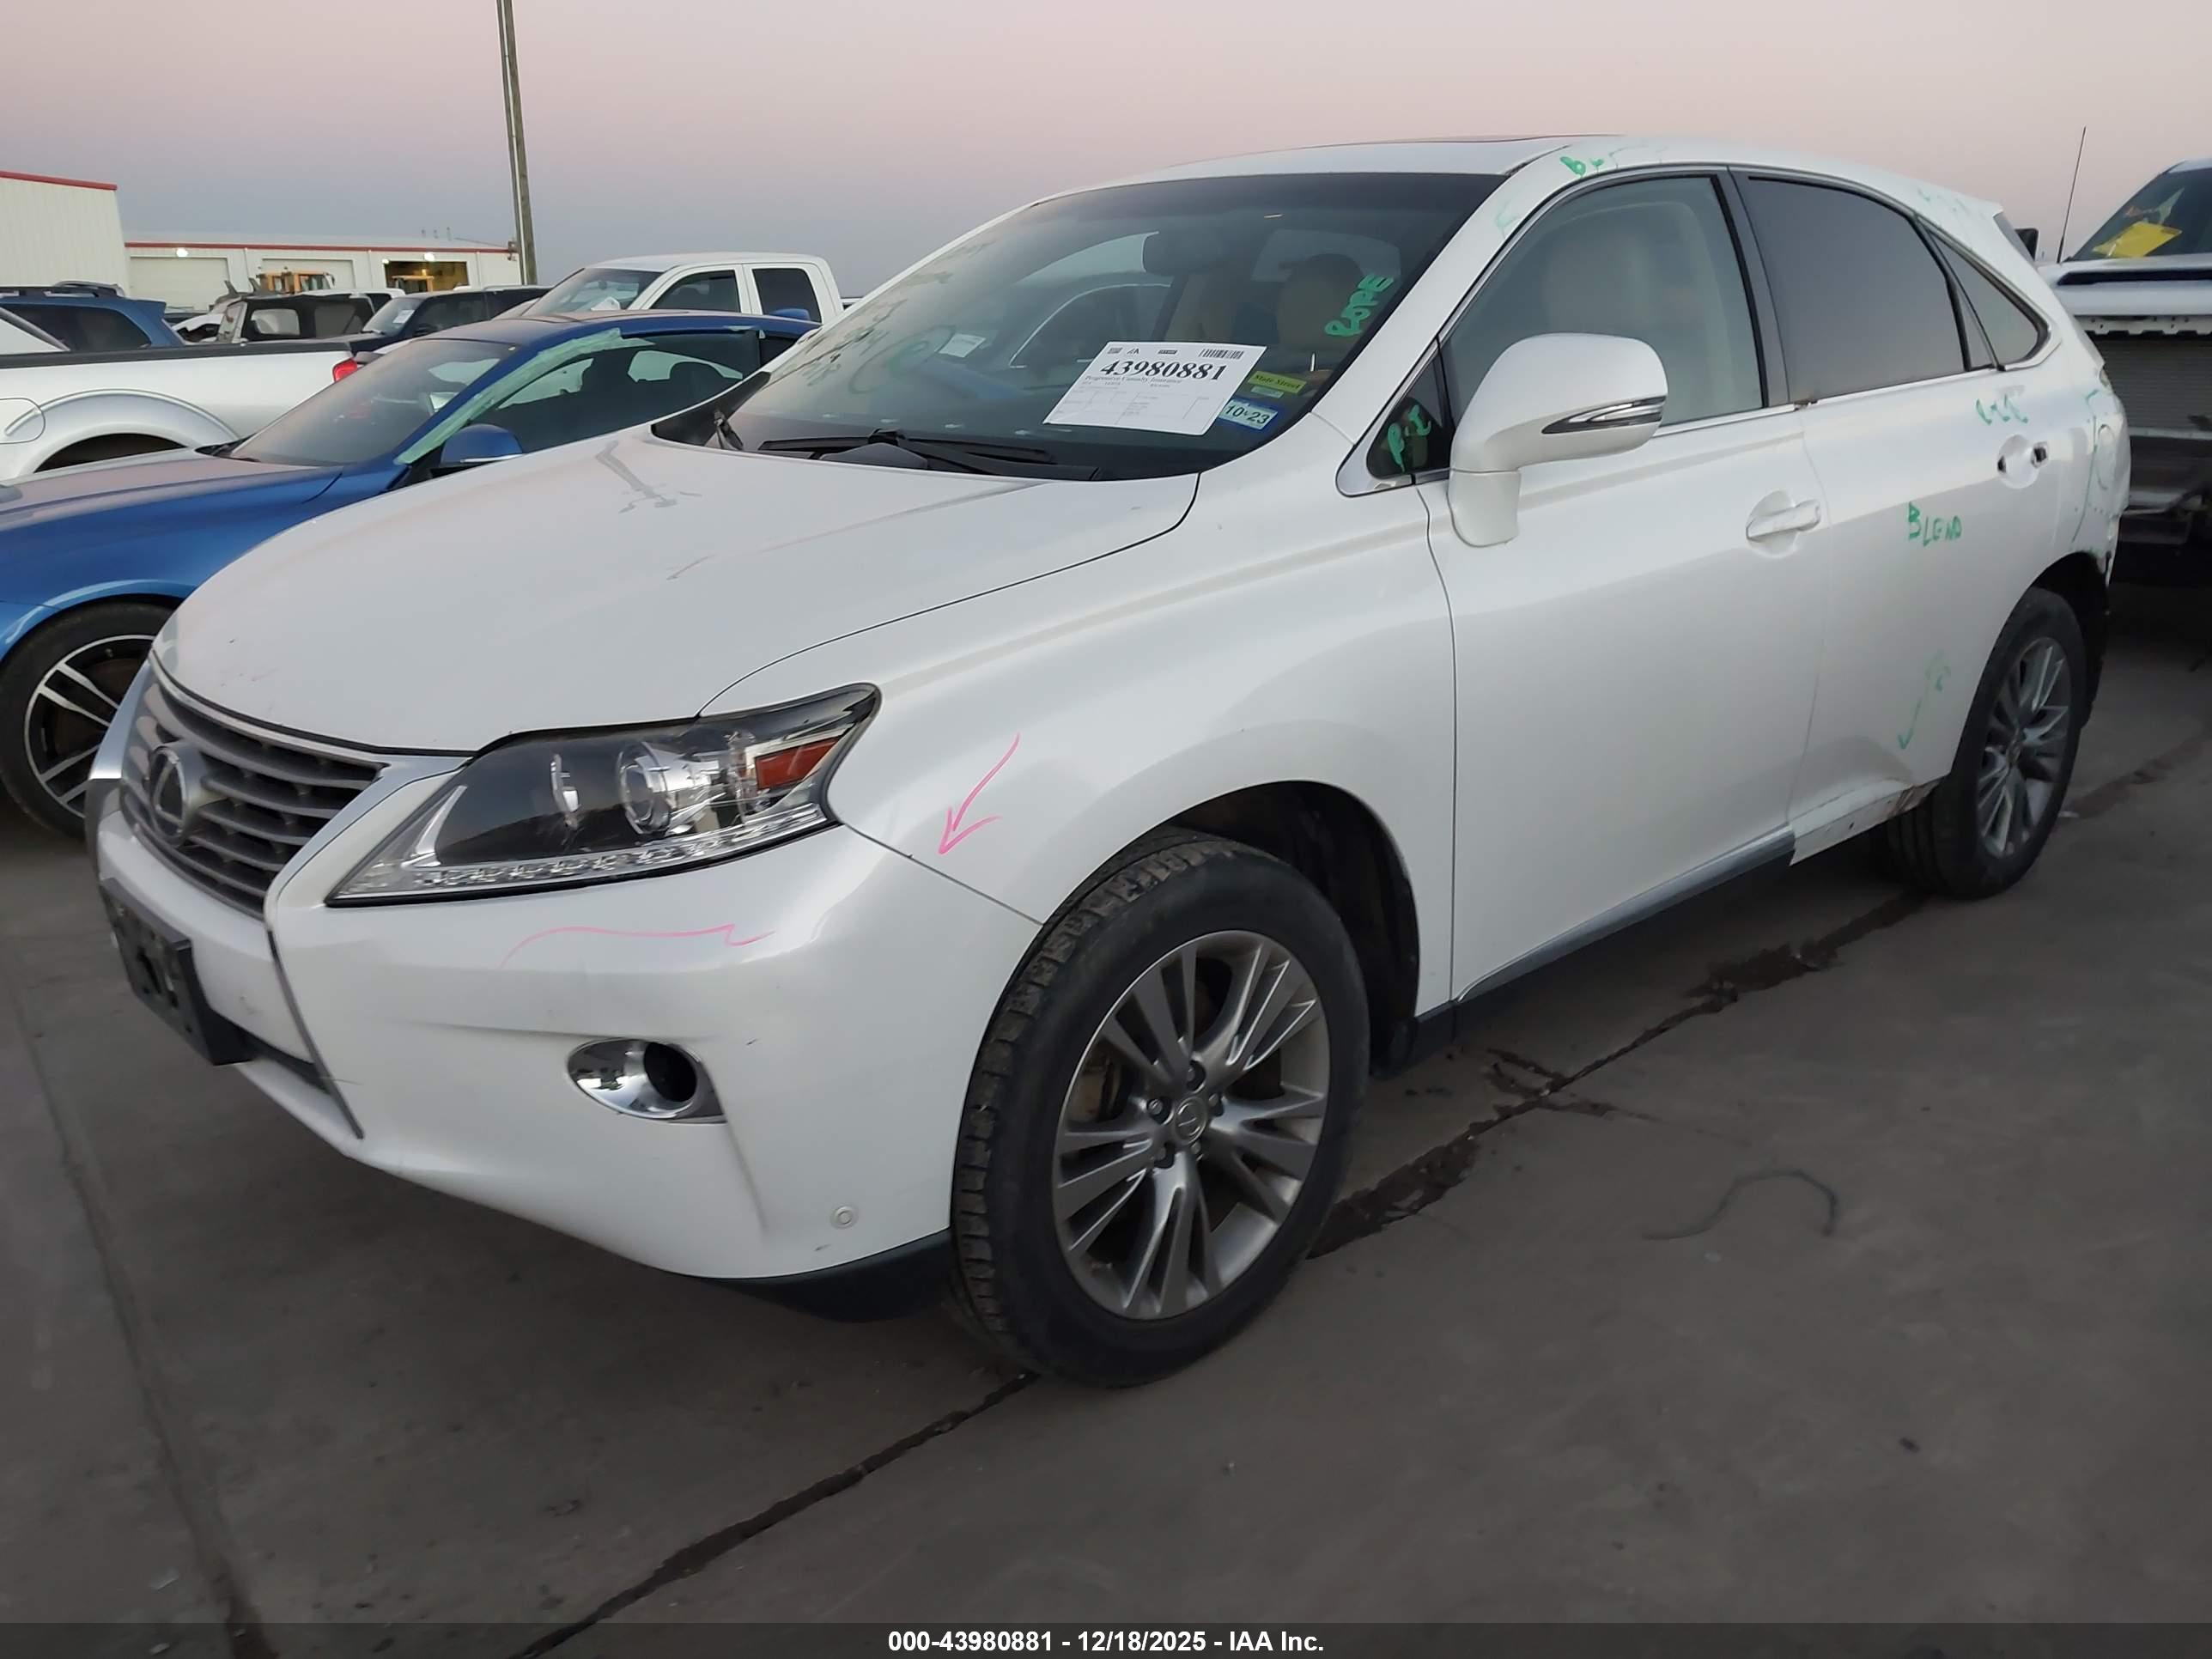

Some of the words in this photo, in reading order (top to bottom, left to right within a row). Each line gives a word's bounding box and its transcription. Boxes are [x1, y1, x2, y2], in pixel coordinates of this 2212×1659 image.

[1100, 360, 1228, 380] 43980881
[1225, 405, 1245, 417] 10
[1247, 412, 1271, 425] 23
